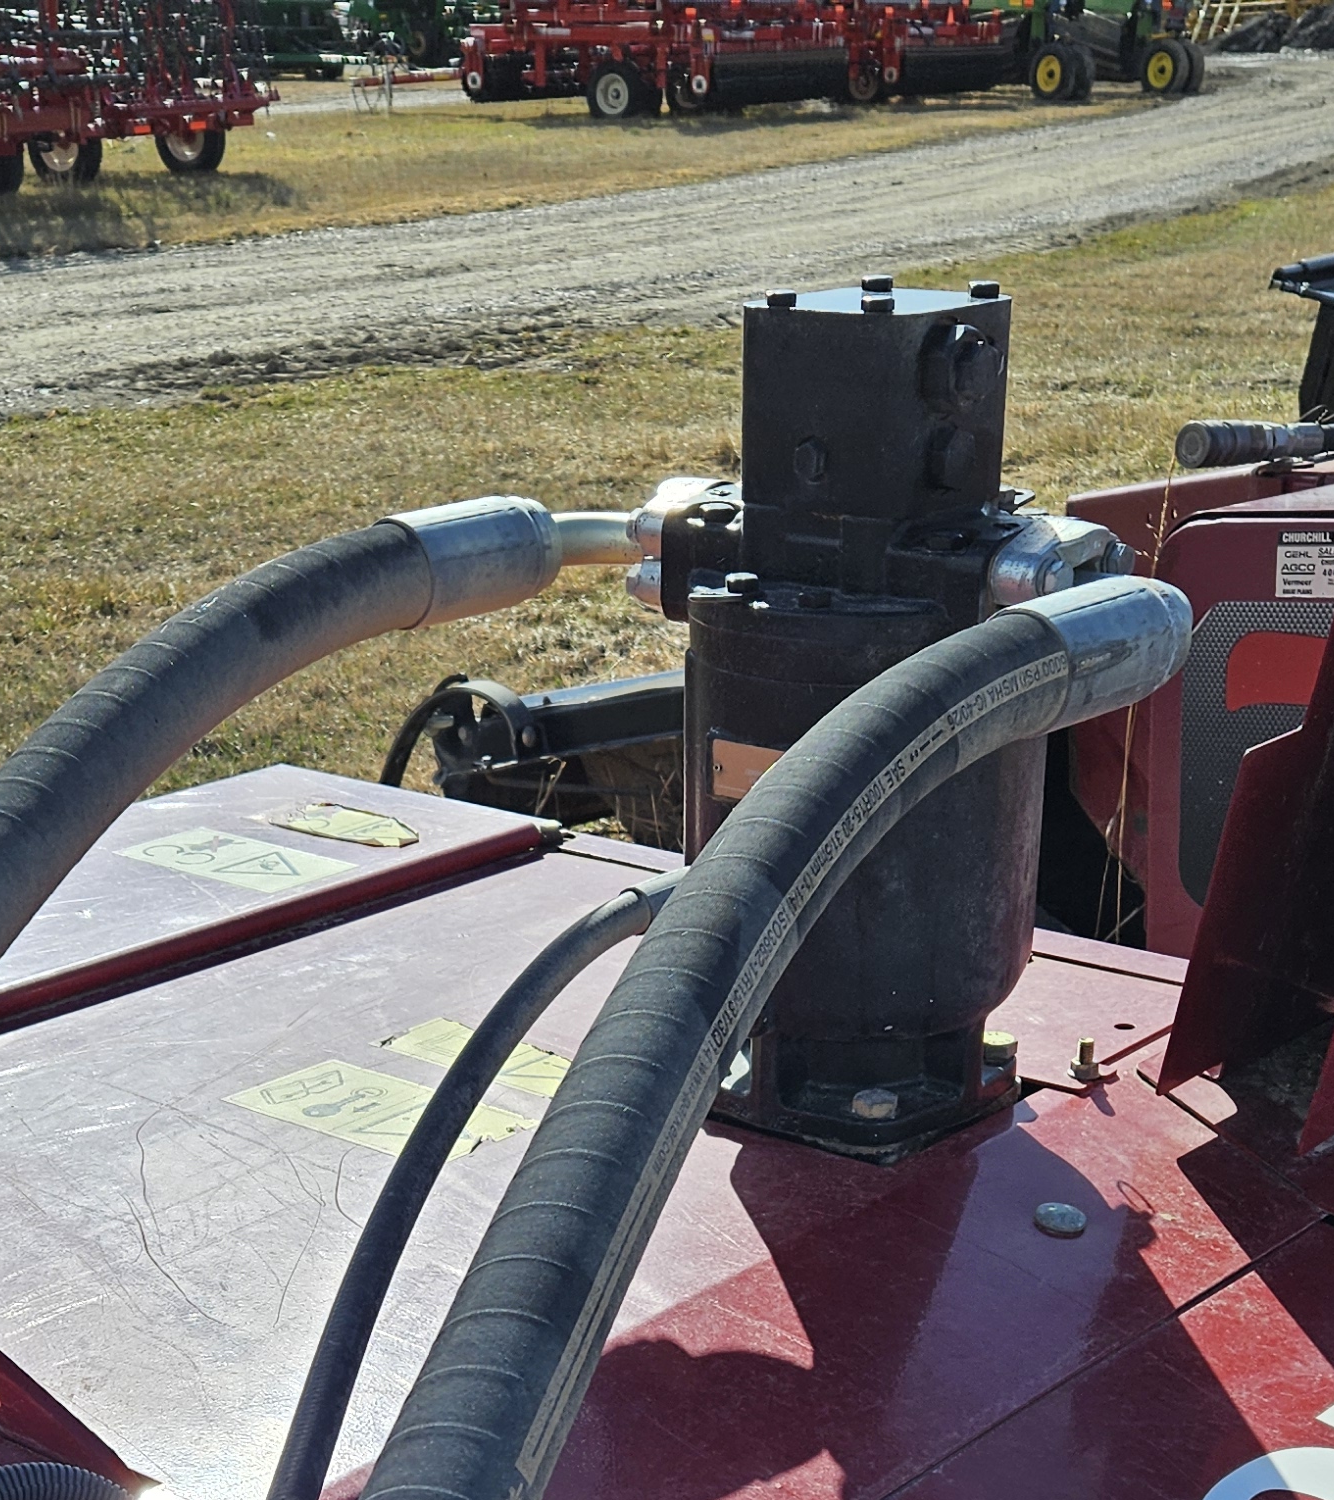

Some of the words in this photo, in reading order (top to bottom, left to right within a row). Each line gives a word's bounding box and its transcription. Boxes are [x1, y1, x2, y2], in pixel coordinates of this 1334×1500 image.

[1282, 532, 1332, 543] CHURCHILL
[1281, 563, 1316, 572] AGCO
[1283, 578, 1312, 586] Vermeer
[881, 757, 908, 789] SAE
